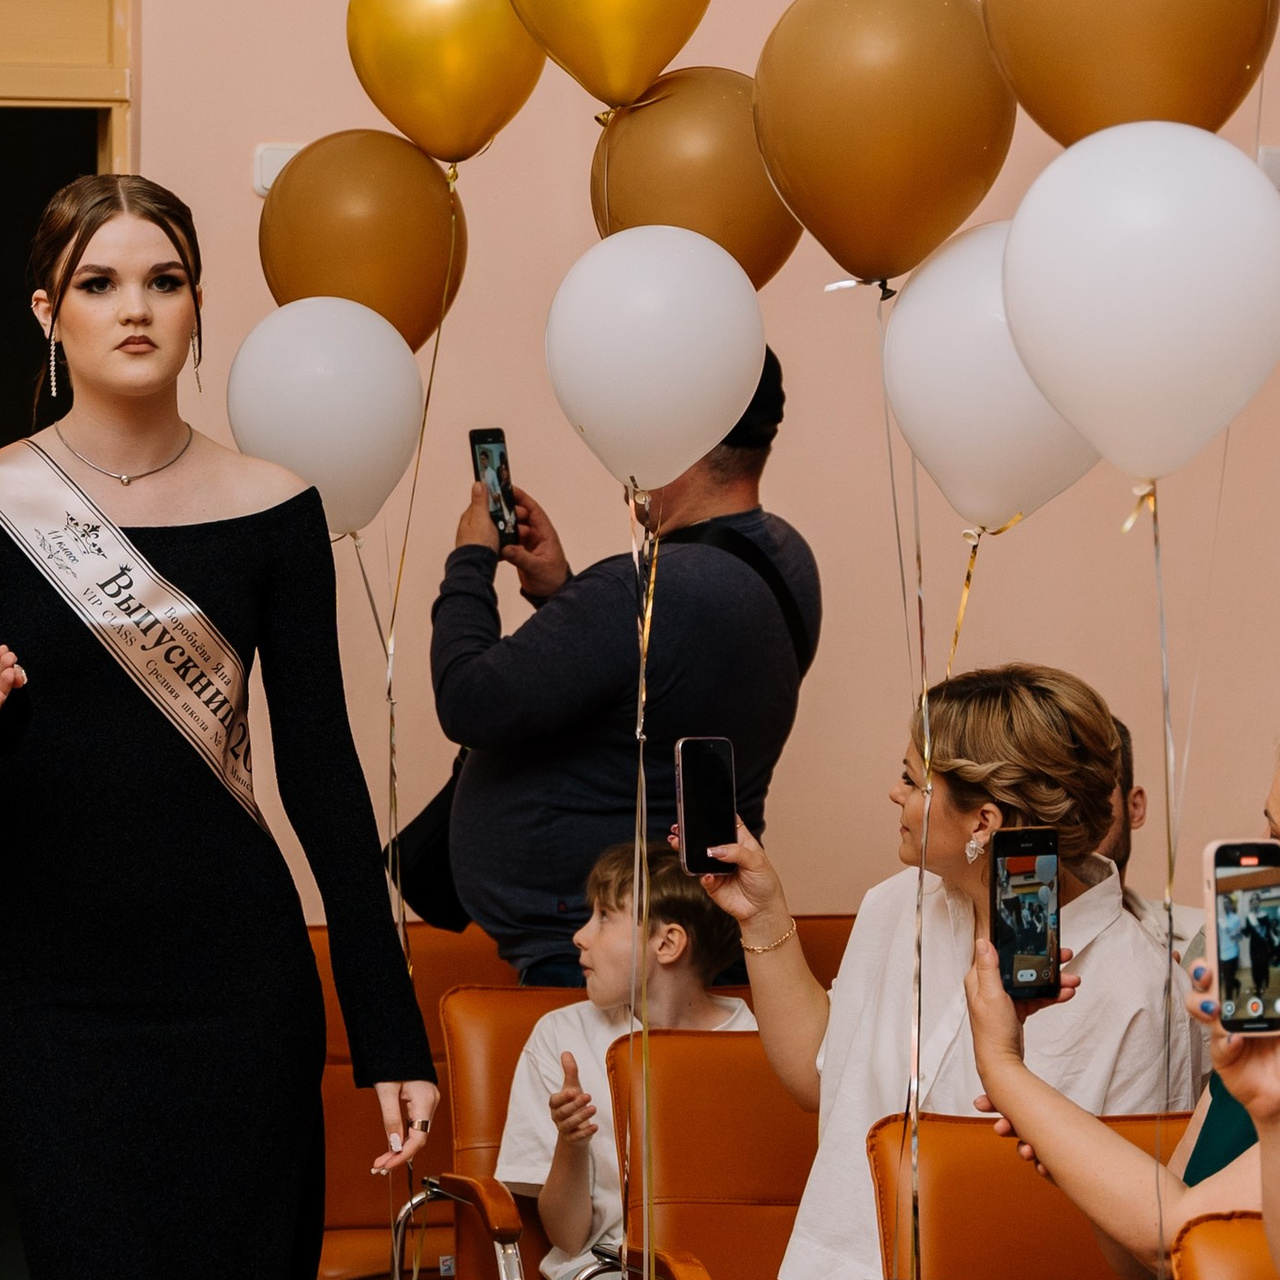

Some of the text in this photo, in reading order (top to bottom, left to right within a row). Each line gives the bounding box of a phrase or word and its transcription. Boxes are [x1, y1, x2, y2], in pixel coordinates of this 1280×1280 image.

[81, 586, 138, 648] VIP CLASS
[164, 606, 233, 688] Воробьёва Яна
[145, 658, 181, 701] Средняя
[181, 701, 210, 733] школа
